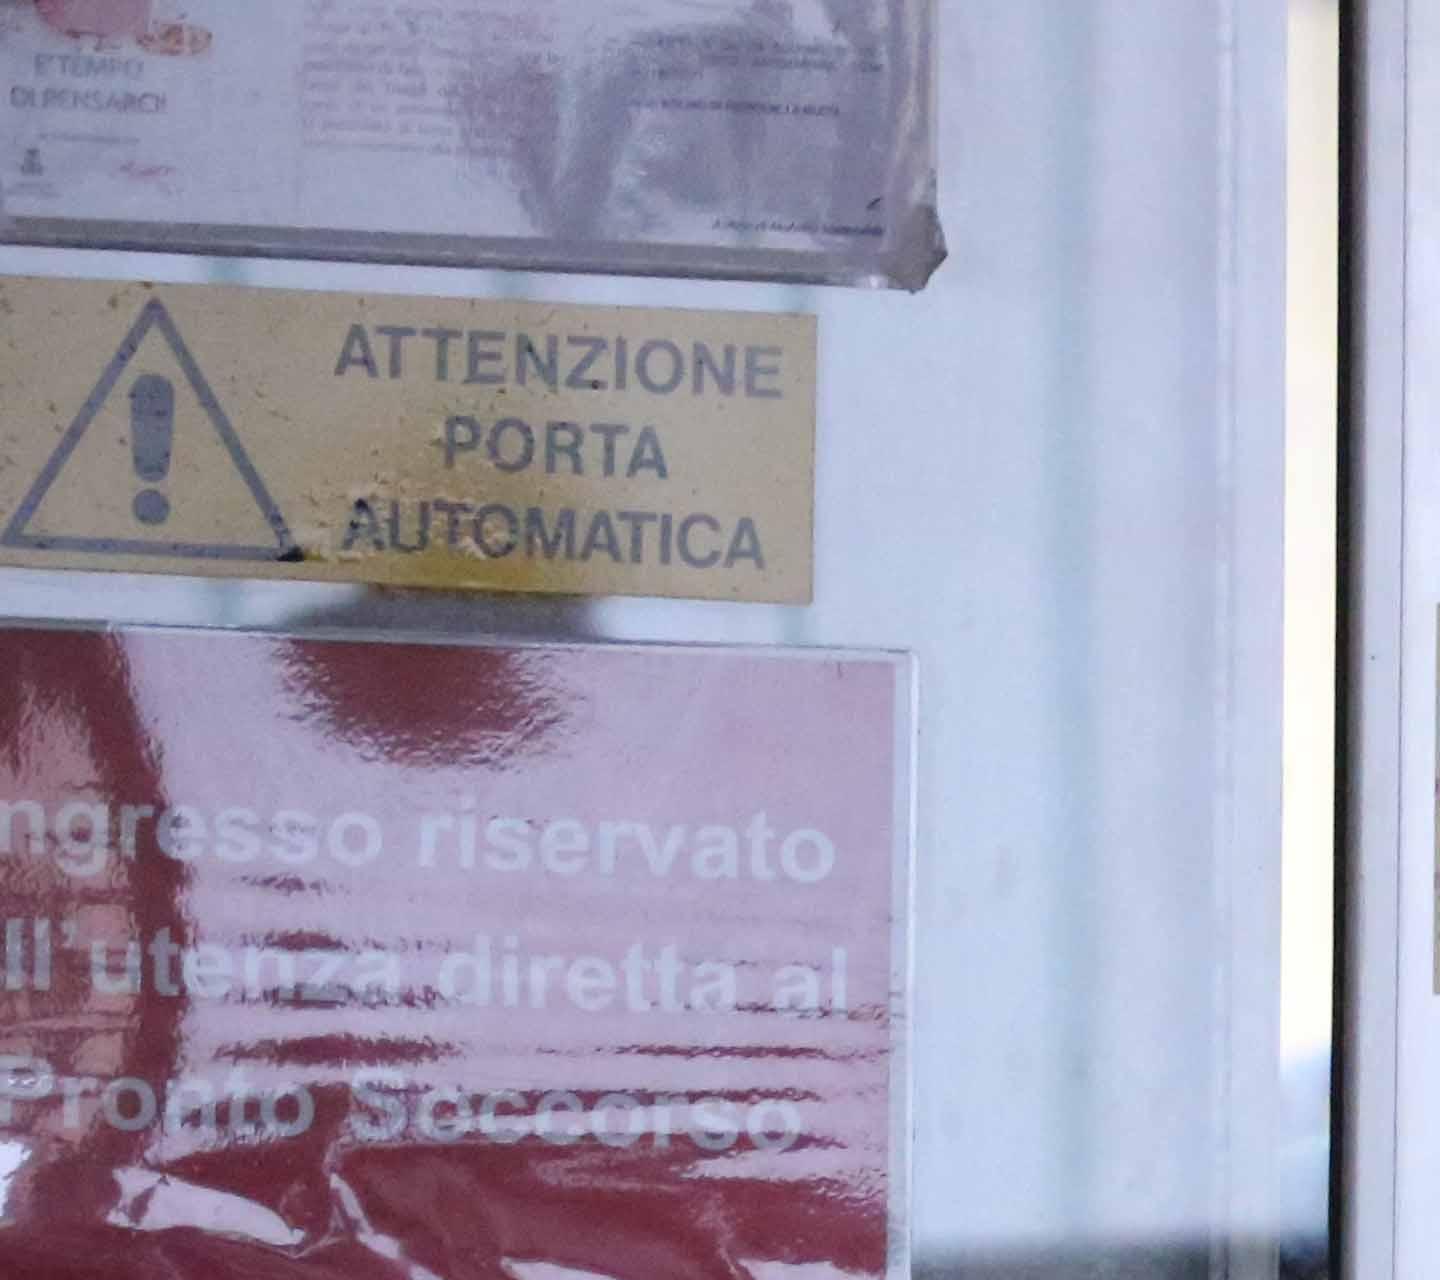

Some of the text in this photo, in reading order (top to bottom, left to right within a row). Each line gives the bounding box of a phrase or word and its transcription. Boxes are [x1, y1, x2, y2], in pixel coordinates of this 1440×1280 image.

[334, 323, 784, 399] ATTENZIONE
[443, 415, 669, 480] PORTA
[340, 498, 766, 571] AUTOMATICA
[417, 797, 837, 884] riservato
[0, 916, 848, 1016] ll'utenza diretta al
[0, 1054, 803, 1151] Pronto Soccorso
